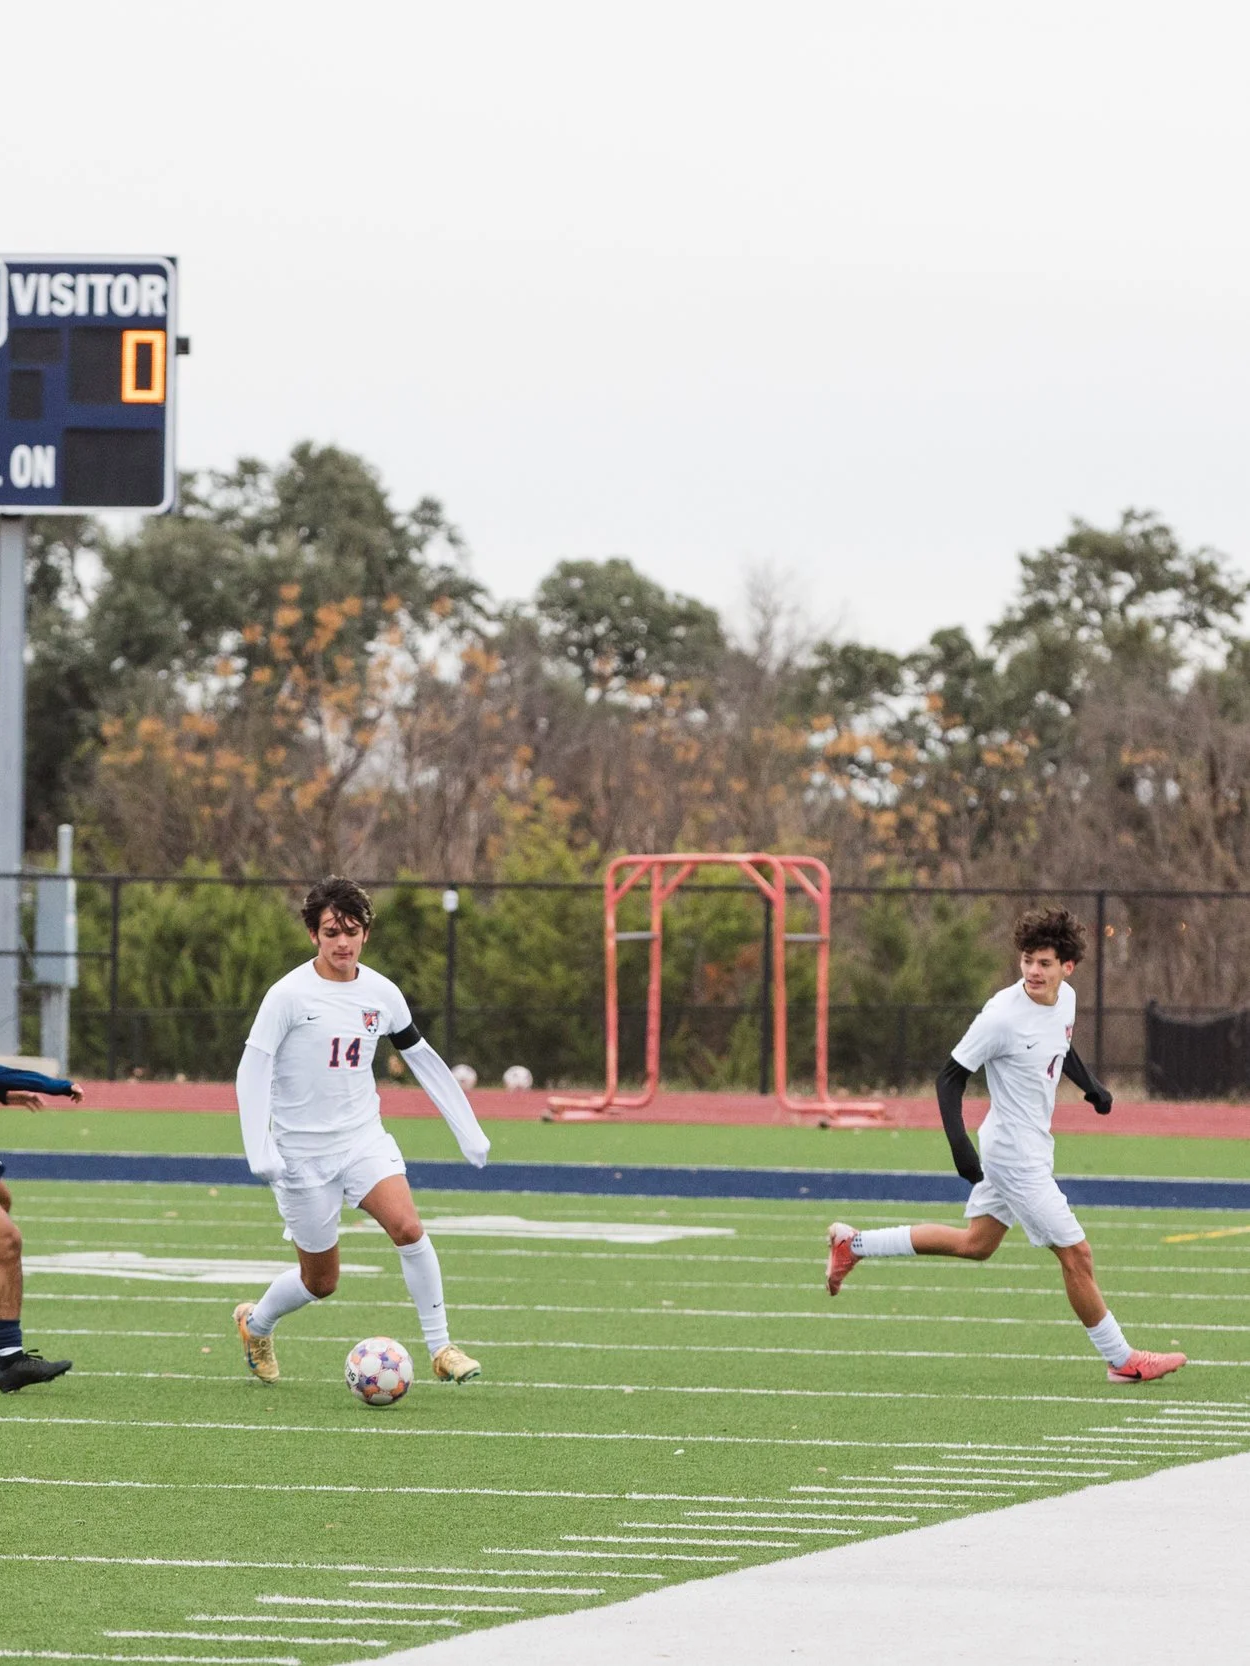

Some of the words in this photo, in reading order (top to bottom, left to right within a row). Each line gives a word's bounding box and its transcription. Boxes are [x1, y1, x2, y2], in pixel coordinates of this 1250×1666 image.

[10, 273, 168, 317] VISITOR
[121, 330, 166, 404] 0
[10, 445, 56, 488] ON
[328, 1037, 361, 1068] 14
